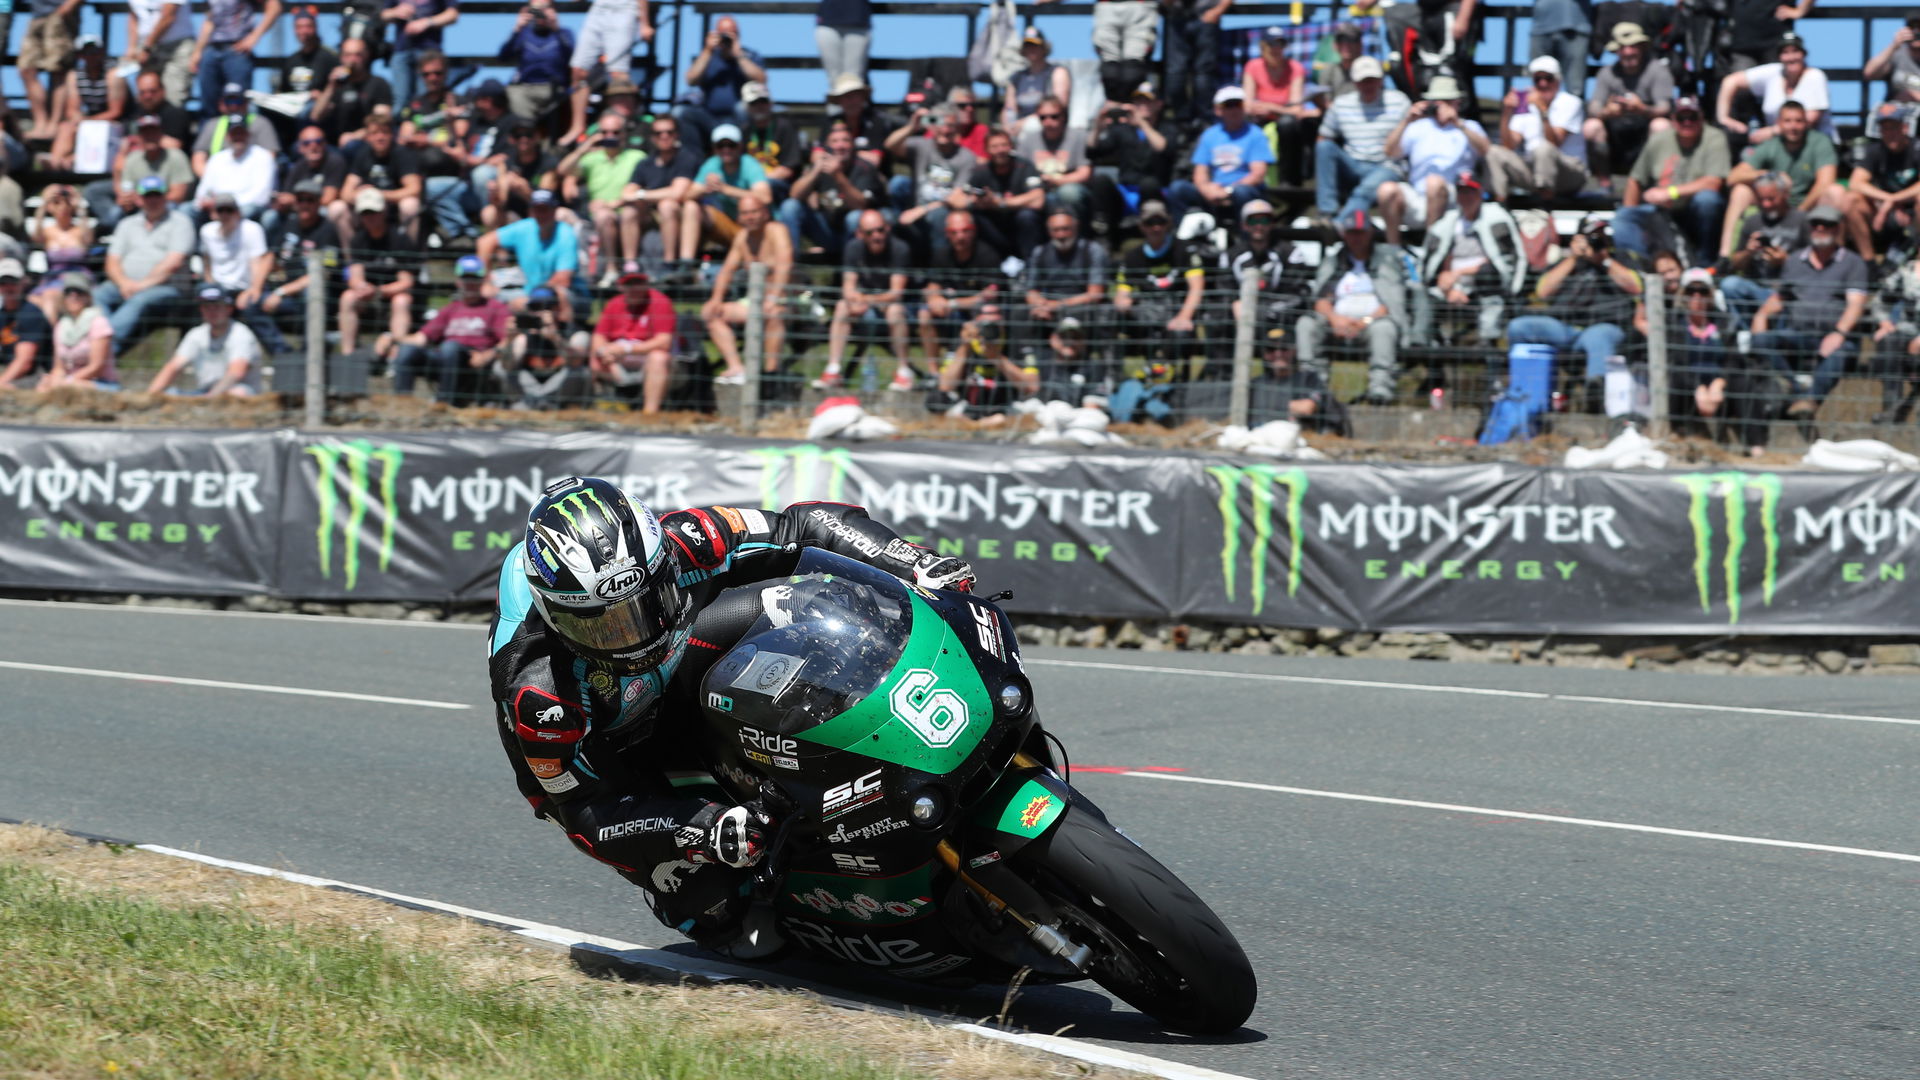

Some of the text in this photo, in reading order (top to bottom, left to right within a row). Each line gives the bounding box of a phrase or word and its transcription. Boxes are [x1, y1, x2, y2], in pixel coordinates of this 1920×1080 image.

[0, 459, 264, 512] MONSTER
[861, 474, 1159, 534] MONSTER
[26, 519, 222, 543] ENERGY
[1318, 495, 1624, 550] MONSTER
[601, 569, 639, 596] Arai
[1365, 559, 1578, 580] ENERGY
[889, 668, 970, 748] 6
[823, 768, 882, 808] SC
[823, 785, 882, 813] PROJECT
[847, 817, 892, 839] SPRINT
[863, 819, 910, 840] FILTER
[832, 853, 881, 868] SC
